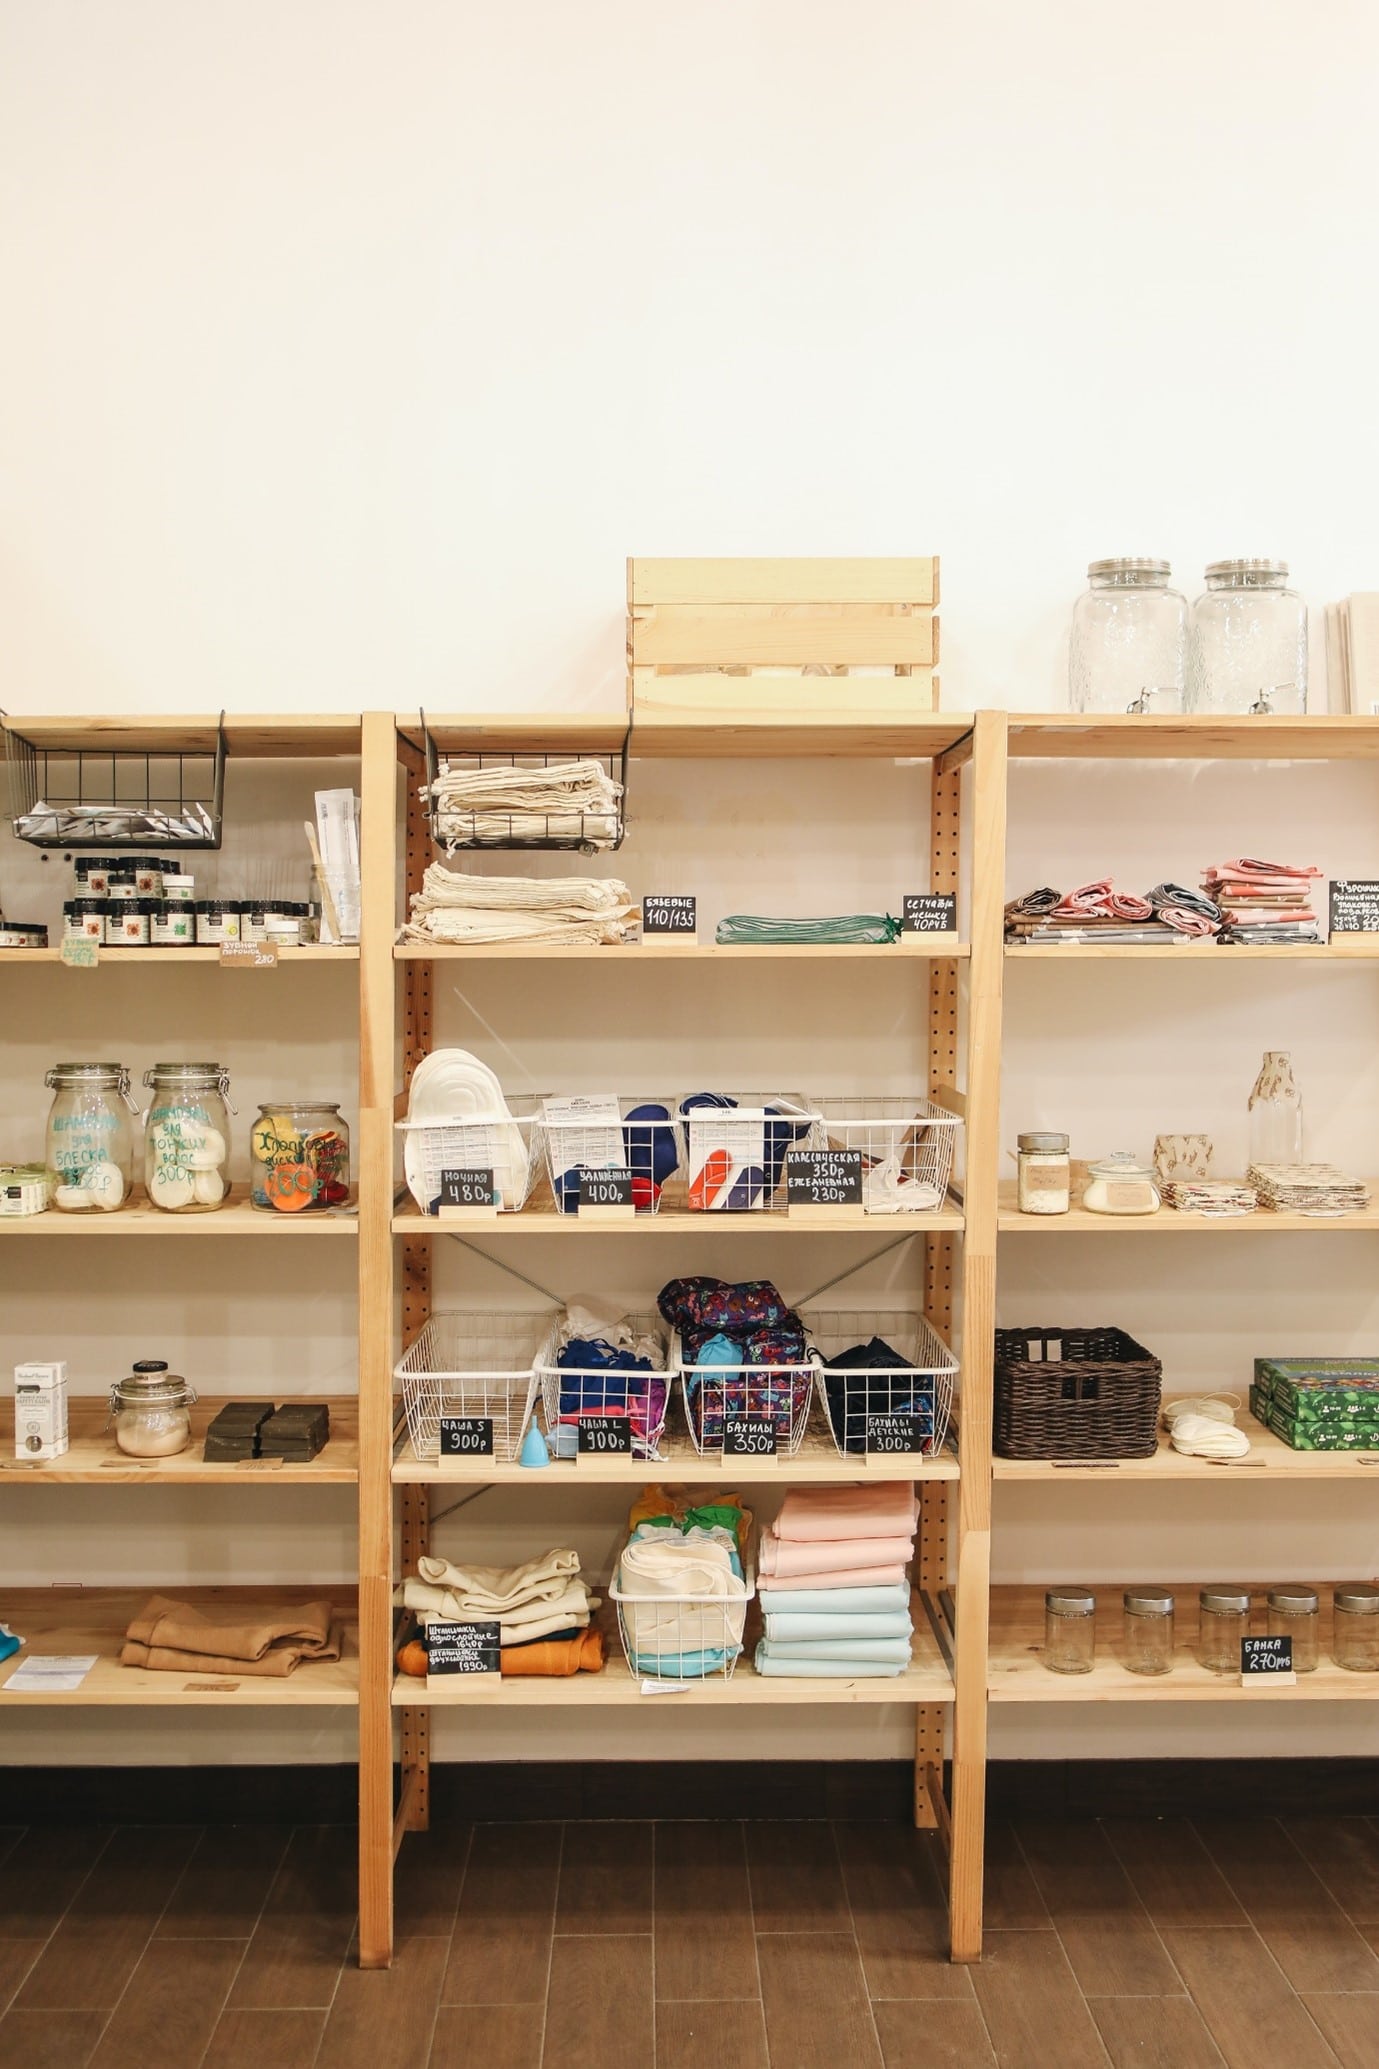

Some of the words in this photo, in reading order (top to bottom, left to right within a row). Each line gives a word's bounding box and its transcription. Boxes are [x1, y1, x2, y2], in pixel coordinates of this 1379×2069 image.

[646, 897, 693, 908] БЯЗЕВЫЕ
[646, 909, 695, 929] 110/135
[787, 1152, 860, 1163] КЛАССИЧЕСКАЯ
[445, 1171, 488, 1183] НОЧНАЯ
[788, 1176, 855, 1187] ЕЖЕДНЕВНАЯ
[588, 1183, 624, 1203] 400р
[442, 1420, 473, 1431] ЧАША
[477, 1420, 486, 1432] S
[579, 1418, 608, 1429] ЧАША
[613, 1419, 623, 1429] L
[727, 1421, 773, 1434] БАХИЛЫ
[868, 1417, 909, 1428] БАХИЛЫ
[868, 1427, 914, 1437] ДЕТСКИЕ
[450, 1432, 487, 1451] 900р
[587, 1431, 625, 1450] 900р
[734, 1433, 774, 1453] 350р
[876, 1437, 912, 1452] 300р
[1244, 1639, 1282, 1653] БАНКА
